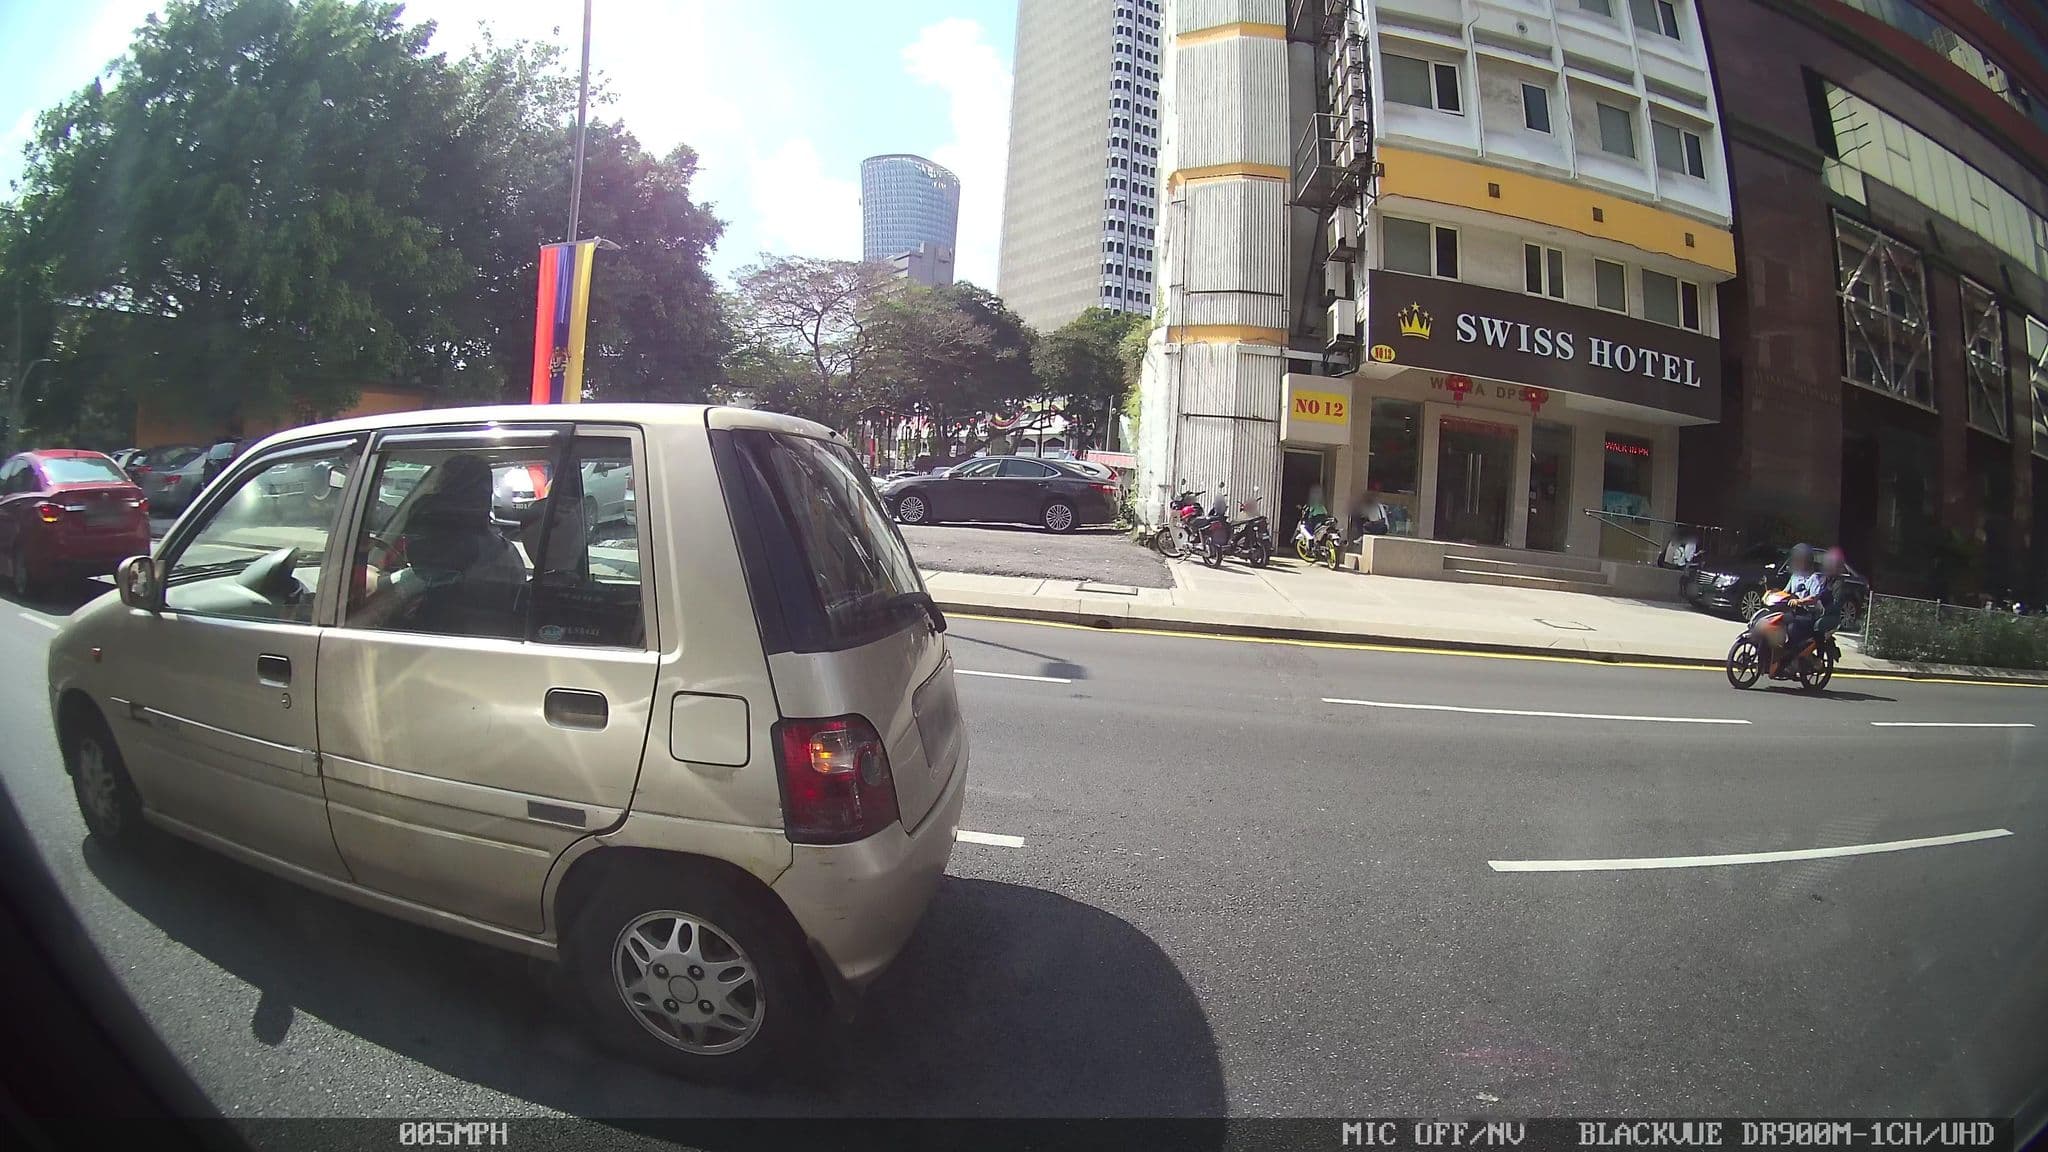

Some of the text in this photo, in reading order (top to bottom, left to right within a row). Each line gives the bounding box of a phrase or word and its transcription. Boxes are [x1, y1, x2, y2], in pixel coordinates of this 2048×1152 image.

[1456, 313, 1575, 360] SWISS
[1588, 337, 1701, 388] HOTEL
[1295, 398, 1344, 417] NO 12
